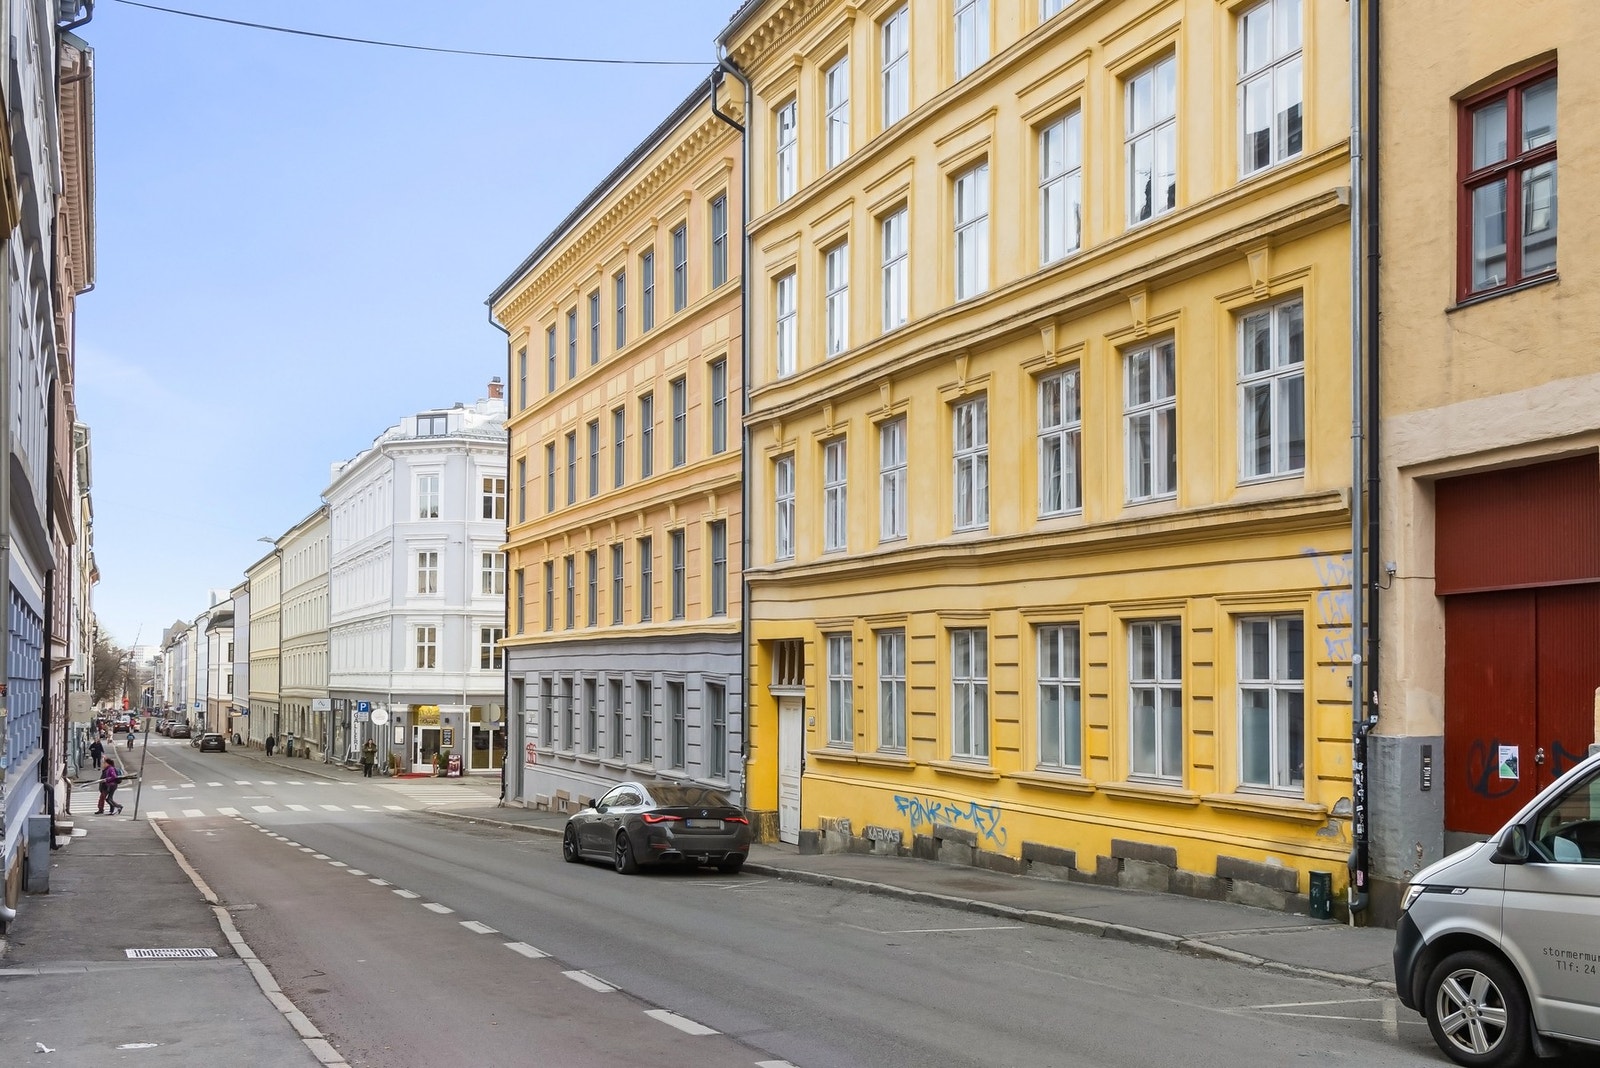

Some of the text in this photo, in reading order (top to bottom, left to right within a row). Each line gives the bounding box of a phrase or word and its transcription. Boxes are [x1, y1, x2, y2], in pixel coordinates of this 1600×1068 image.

[361, 703, 366, 711] P
[1556, 960, 1596, 975] Tlf: 24
